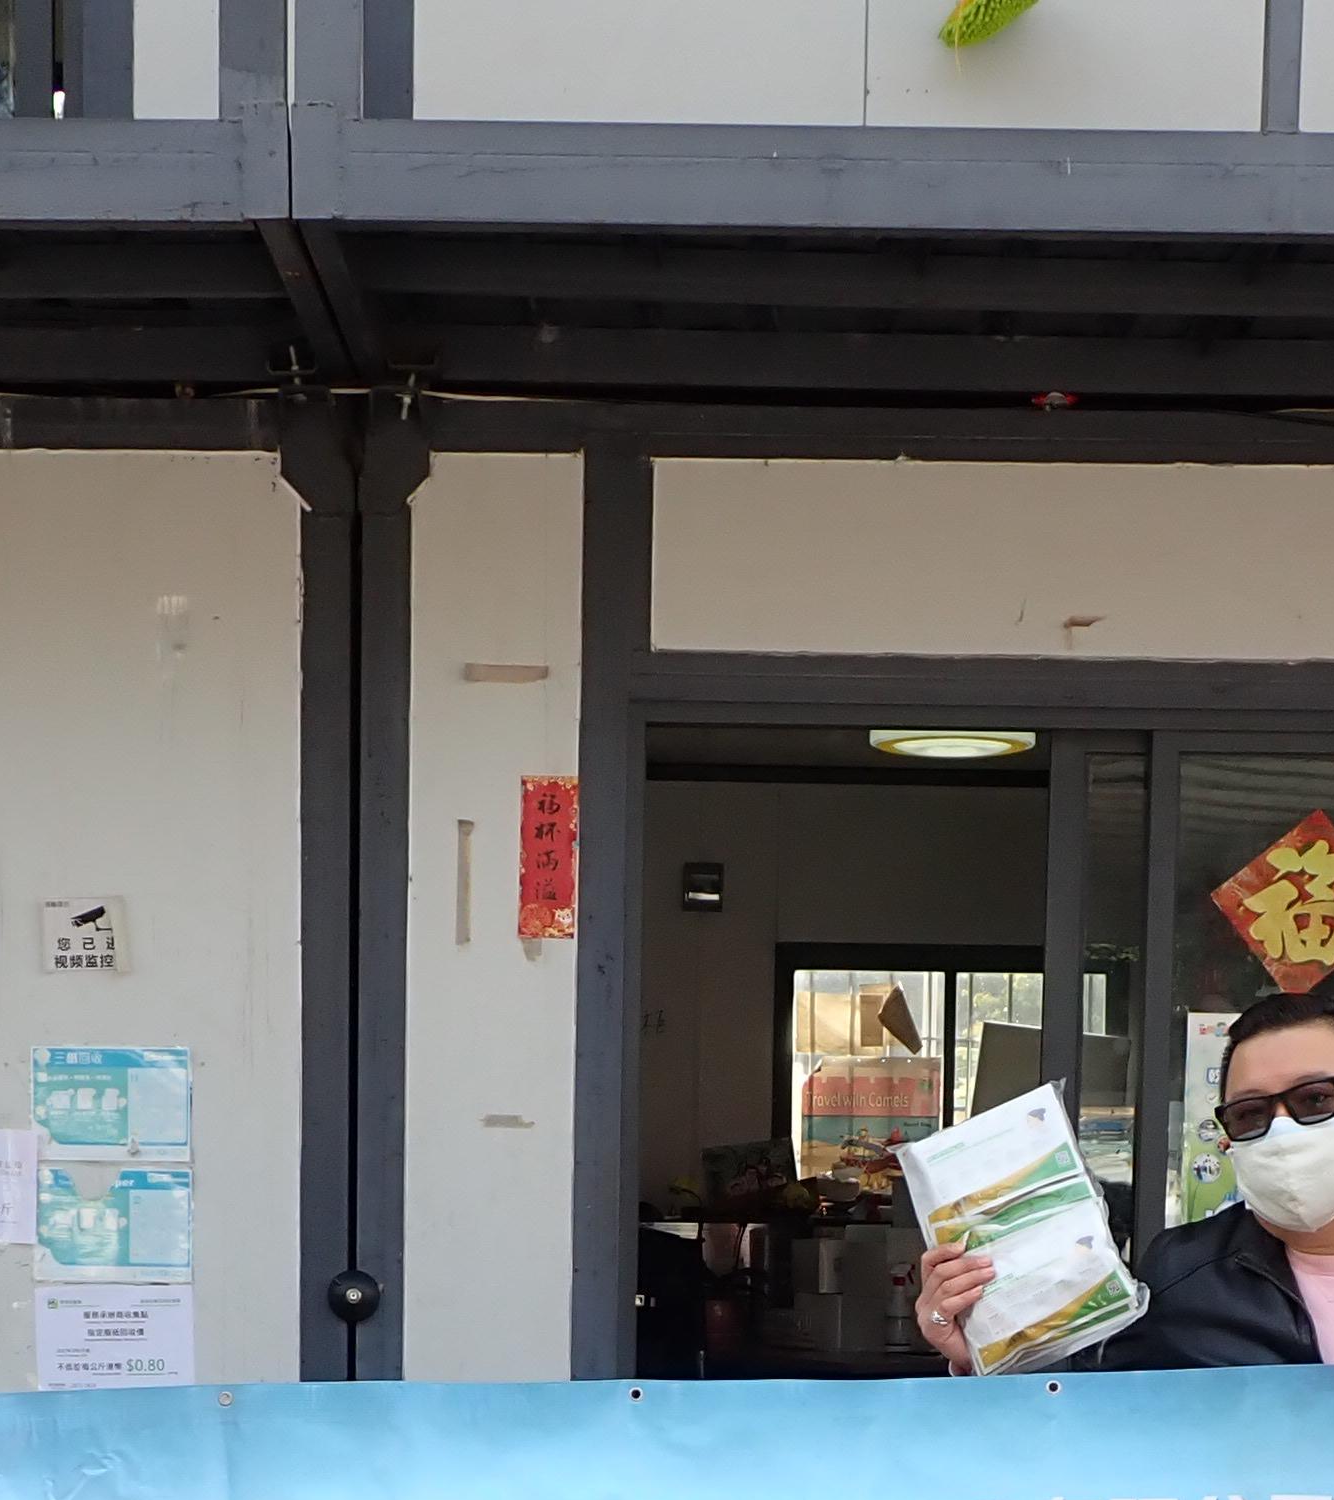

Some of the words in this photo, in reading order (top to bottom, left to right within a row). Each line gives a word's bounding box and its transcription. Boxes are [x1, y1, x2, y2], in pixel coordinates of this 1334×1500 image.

[54, 954, 114, 969] 视频监控
[868, 1091, 909, 1108] Camels
[126, 1359, 165, 1372] $0.80
